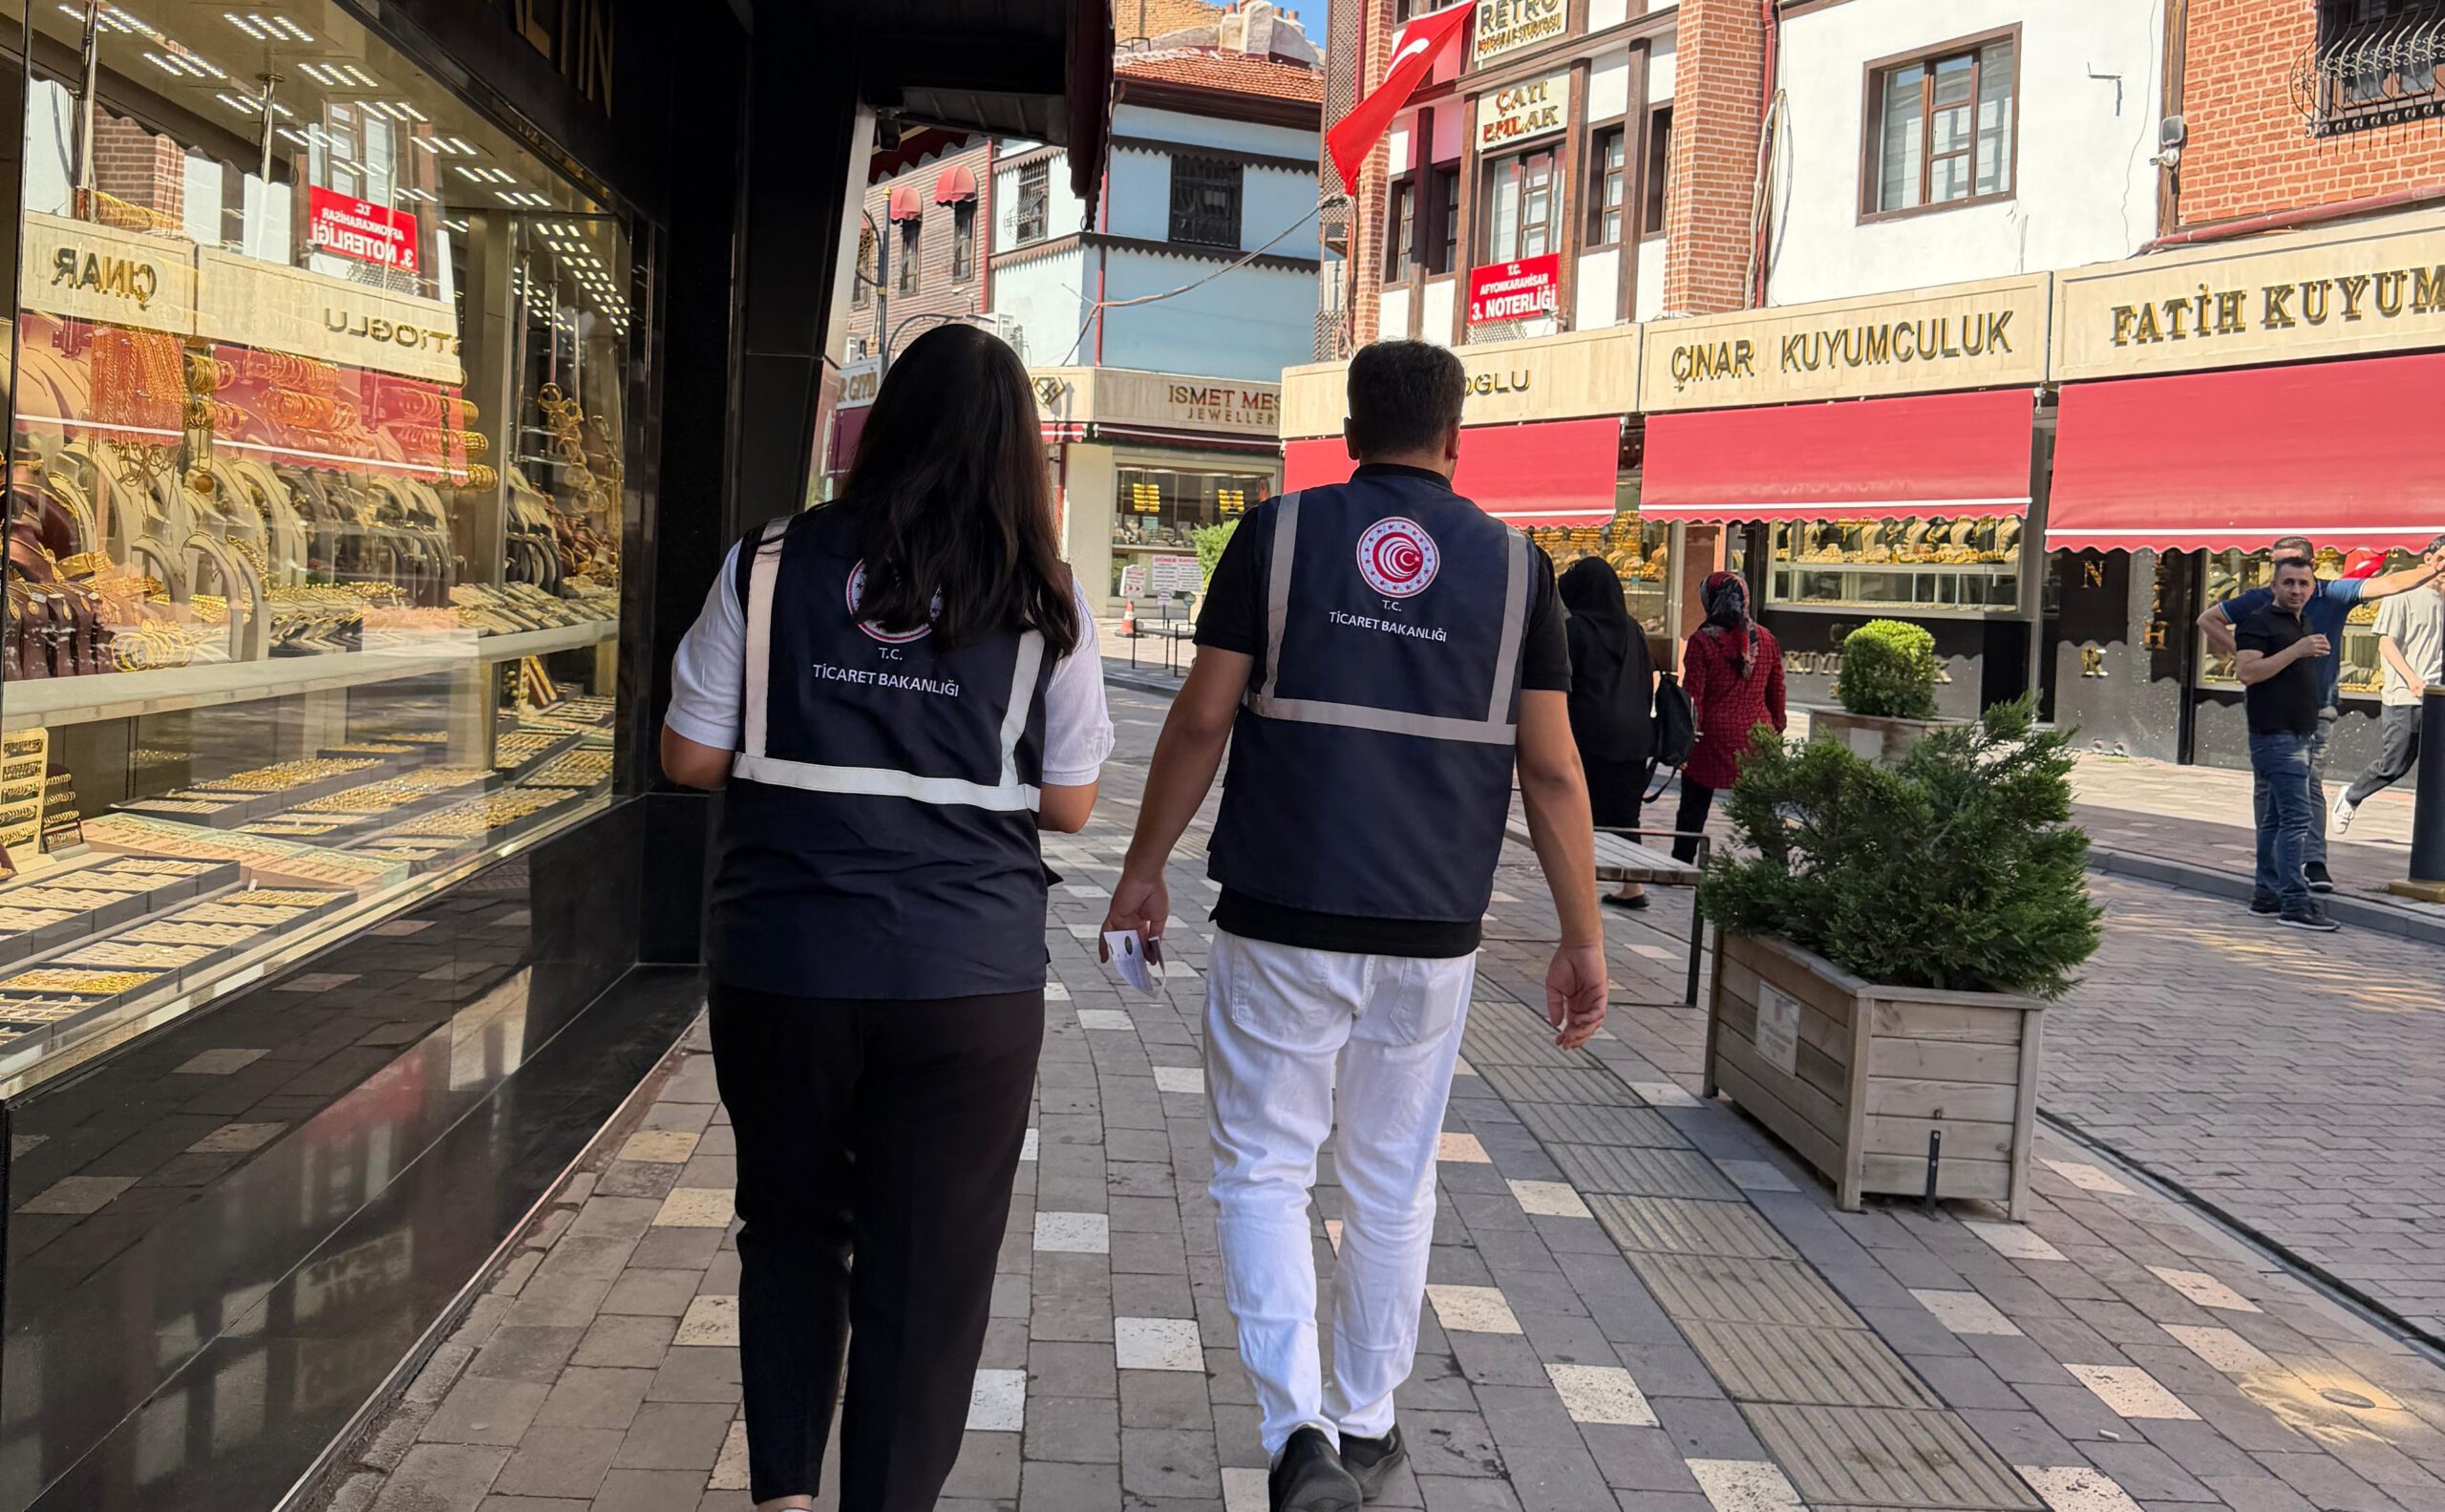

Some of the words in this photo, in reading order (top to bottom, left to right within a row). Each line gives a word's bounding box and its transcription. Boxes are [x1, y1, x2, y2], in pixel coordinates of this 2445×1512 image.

[1480, 0, 1559, 35] RETRO
[1496, 81, 1547, 117] ÇATI
[1483, 106, 1558, 143] EMLAK
[1472, 302, 1483, 321] 3.
[1485, 283, 1557, 318] NOTERLİĞİ
[1479, 273, 1549, 296] AFYONKARAHİSAR
[2110, 283, 2247, 348] FATİH
[1671, 339, 1754, 393] ÇINAR
[1780, 310, 2014, 373] KUYUMCULUK
[1382, 599, 1402, 611] T.C.
[1329, 610, 1380, 630] TİCARET
[1381, 620, 1447, 643] BAKANLIĞI
[878, 647, 904, 661] T.C.
[812, 662, 877, 685] TİCARET
[878, 672, 960, 697] BAKANLIĞI
